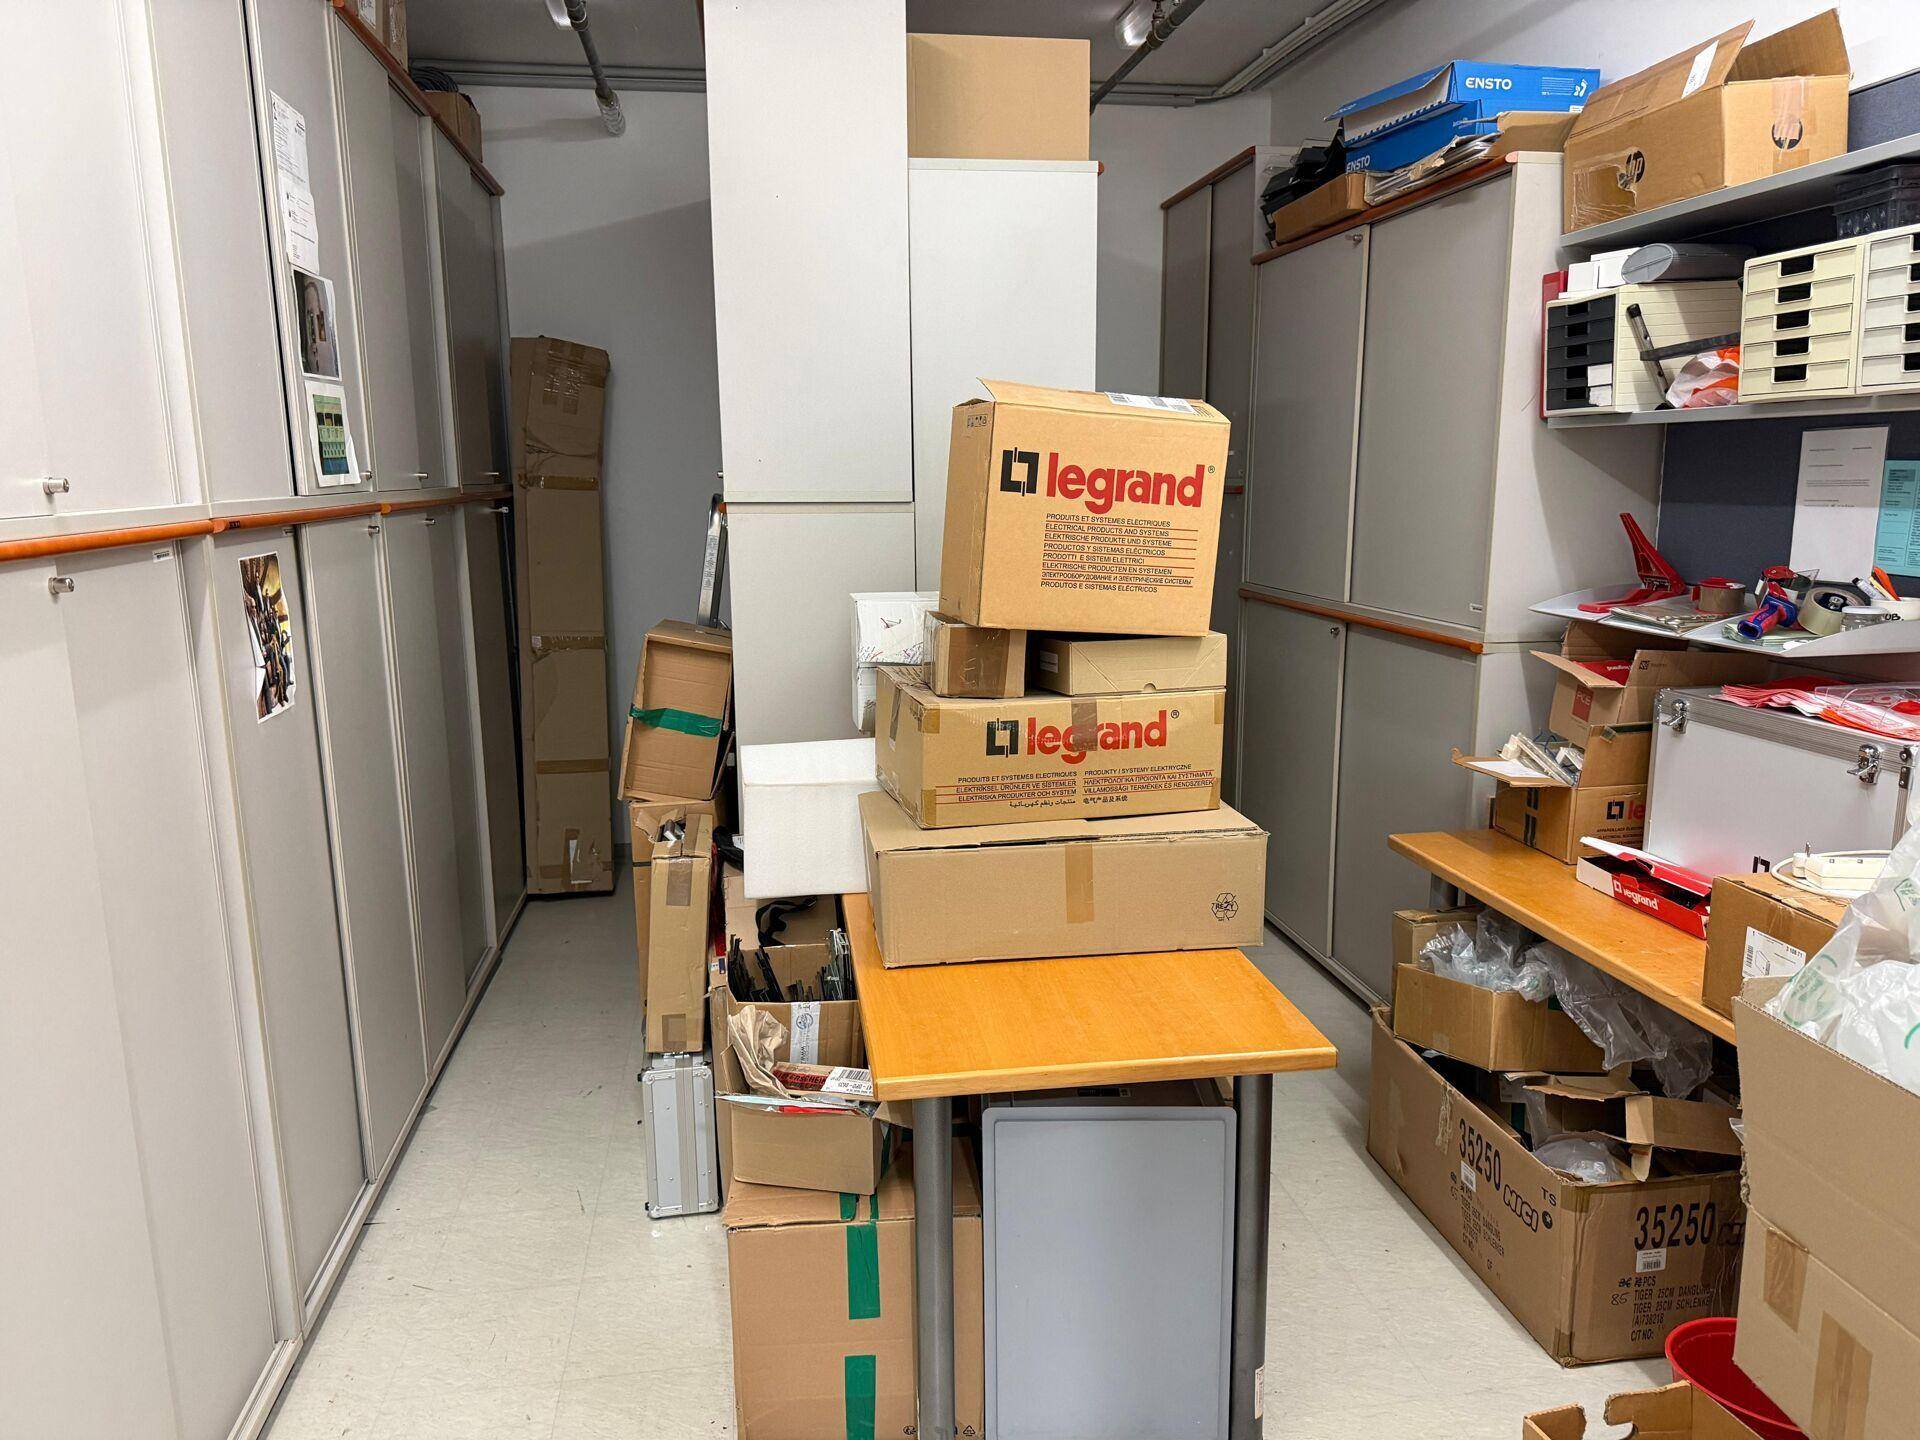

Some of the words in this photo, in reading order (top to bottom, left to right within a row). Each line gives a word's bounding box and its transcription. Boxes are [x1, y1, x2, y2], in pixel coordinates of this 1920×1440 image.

[1465, 77, 1512, 90] ENSTO
[1346, 155, 1371, 173] ENSTO
[1046, 513, 1080, 521] PRODUITS
[1090, 516, 1126, 525] SYSTEMES
[1045, 523, 1086, 532] ELECTRICAL
[1087, 526, 1123, 534] PRODUCTS
[1138, 529, 1170, 537] SYSTEMS
[1044, 532, 1090, 542] ELEKTRISCHE
[1090, 536, 1126, 544] PRODUKTE
[1044, 542, 1086, 552] PRODUCTOS
[1085, 554, 1112, 562] SISTEMI
[1112, 556, 1145, 564] ELETTRICI
[1042, 562, 1086, 570] ELEKTRISCHE
[1088, 564, 1128, 572] PRODUCTEN
[1040, 581, 1078, 589] PRODUTOS
[1150, 764, 1192, 772] ELEKTRYCZNE
[1173, 780, 1213, 788] RENDSZEREK
[958, 794, 997, 802] ELEKTRISKA
[1460, 1118, 1501, 1191] 35250
[1541, 1186, 1557, 1207] TS
[1634, 1202, 1716, 1250] 35250
[1634, 1289, 1653, 1301] TIGER
[1658, 1286, 1675, 1299] 25CM
[1634, 1302, 1652, 1314] TIGER
[1655, 1300, 1673, 1312] 25CM
